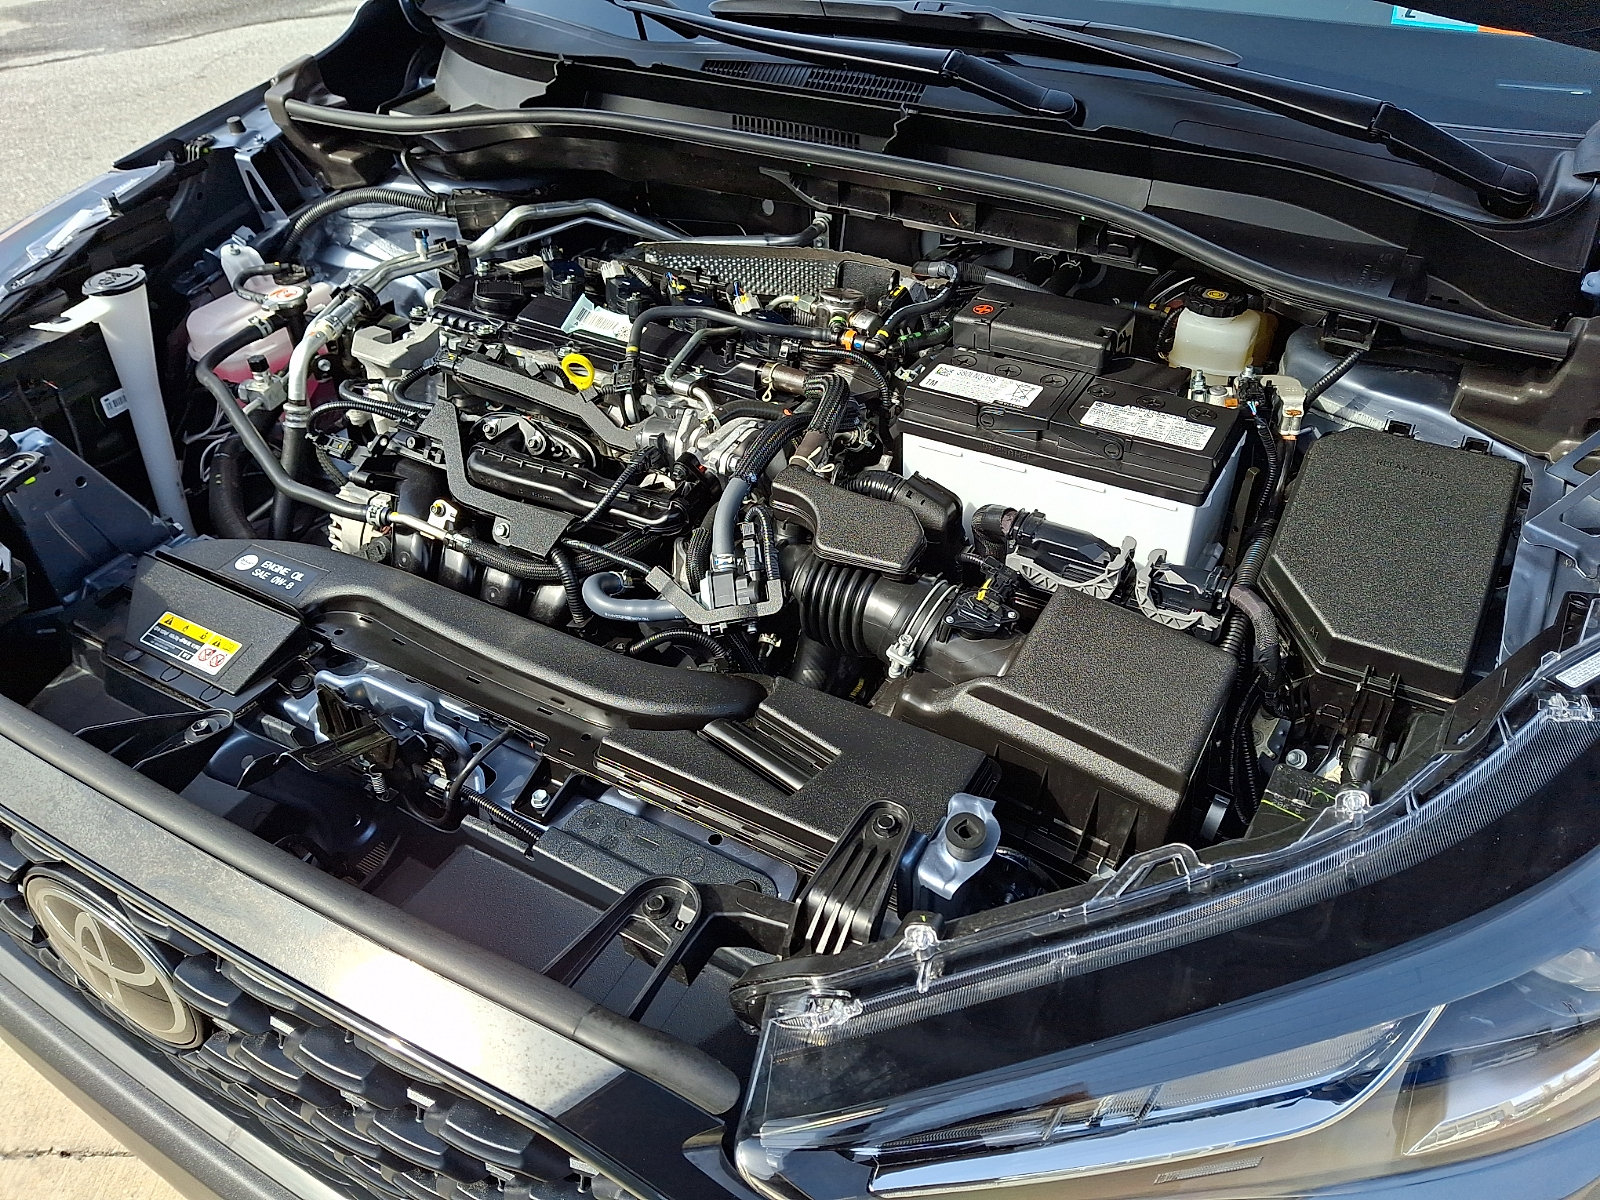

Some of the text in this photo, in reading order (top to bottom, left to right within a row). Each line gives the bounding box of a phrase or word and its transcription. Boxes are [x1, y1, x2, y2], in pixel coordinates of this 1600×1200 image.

[251, 568, 295, 590] SAE 0W-8
[260, 560, 291, 576] ENGINE
[290, 571, 305, 582] OIL
